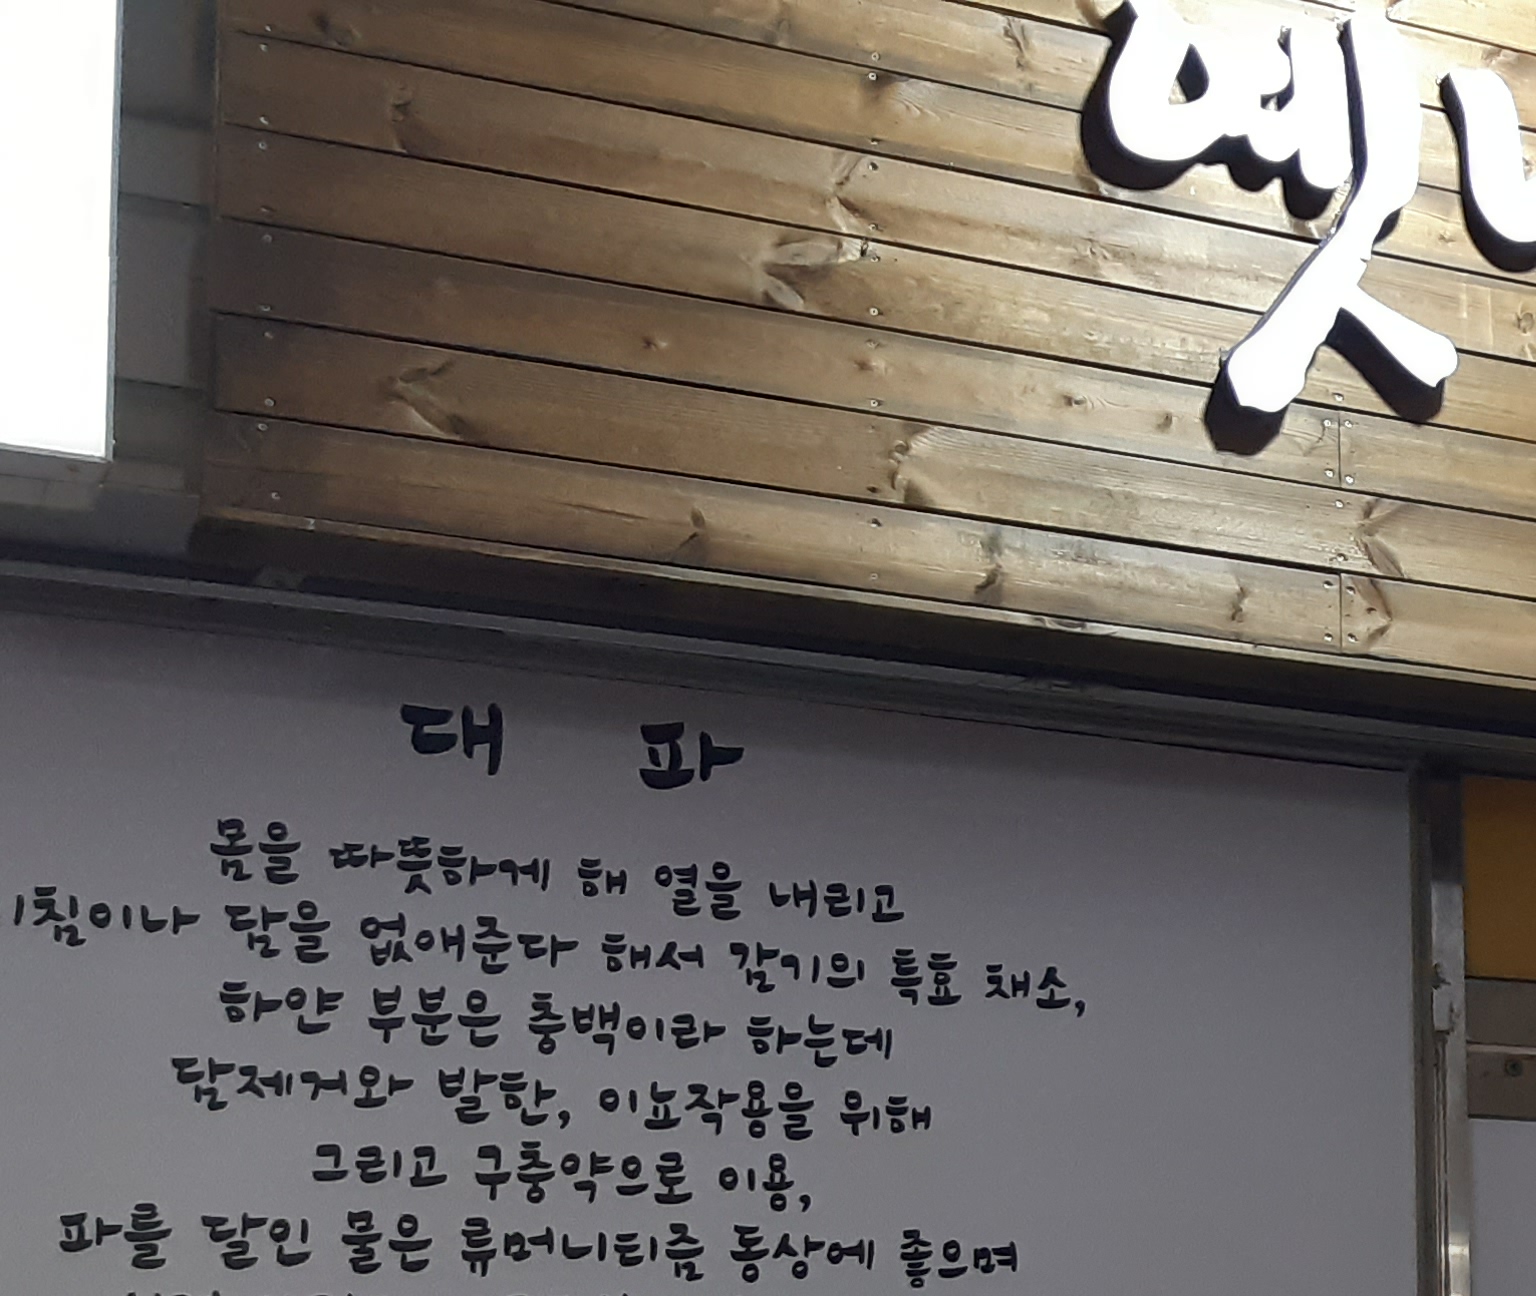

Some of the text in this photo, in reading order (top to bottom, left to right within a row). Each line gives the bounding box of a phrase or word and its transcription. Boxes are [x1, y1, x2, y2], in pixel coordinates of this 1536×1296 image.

[399, 702, 745, 790] 대 파
[209, 818, 905, 923] 몸을 따뜻하게 해 열을 내리고
[224, 900, 331, 964] 담을
[359, 912, 580, 975] 없애준다
[601, 933, 704, 973] 해서
[729, 941, 865, 994] 감기의
[984, 963, 1086, 1018] 채소,
[219, 981, 345, 1035] 하얀
[367, 984, 502, 1049] 부분은
[746, 1013, 893, 1069] 하는데
[438, 1066, 571, 1130] 발한,
[599, 1079, 815, 1141] 이뇨작용을
[839, 1090, 932, 1137] 위해
[311, 1140, 811, 1213] 그리고 구충약으로 이용,
[59, 1202, 173, 1270] 파를
[200, 1212, 312, 1271] 달인
[341, 1210, 433, 1275] 물은
[729, 1224, 875, 1284] 동상에
[899, 1229, 1018, 1289] 좋으며
